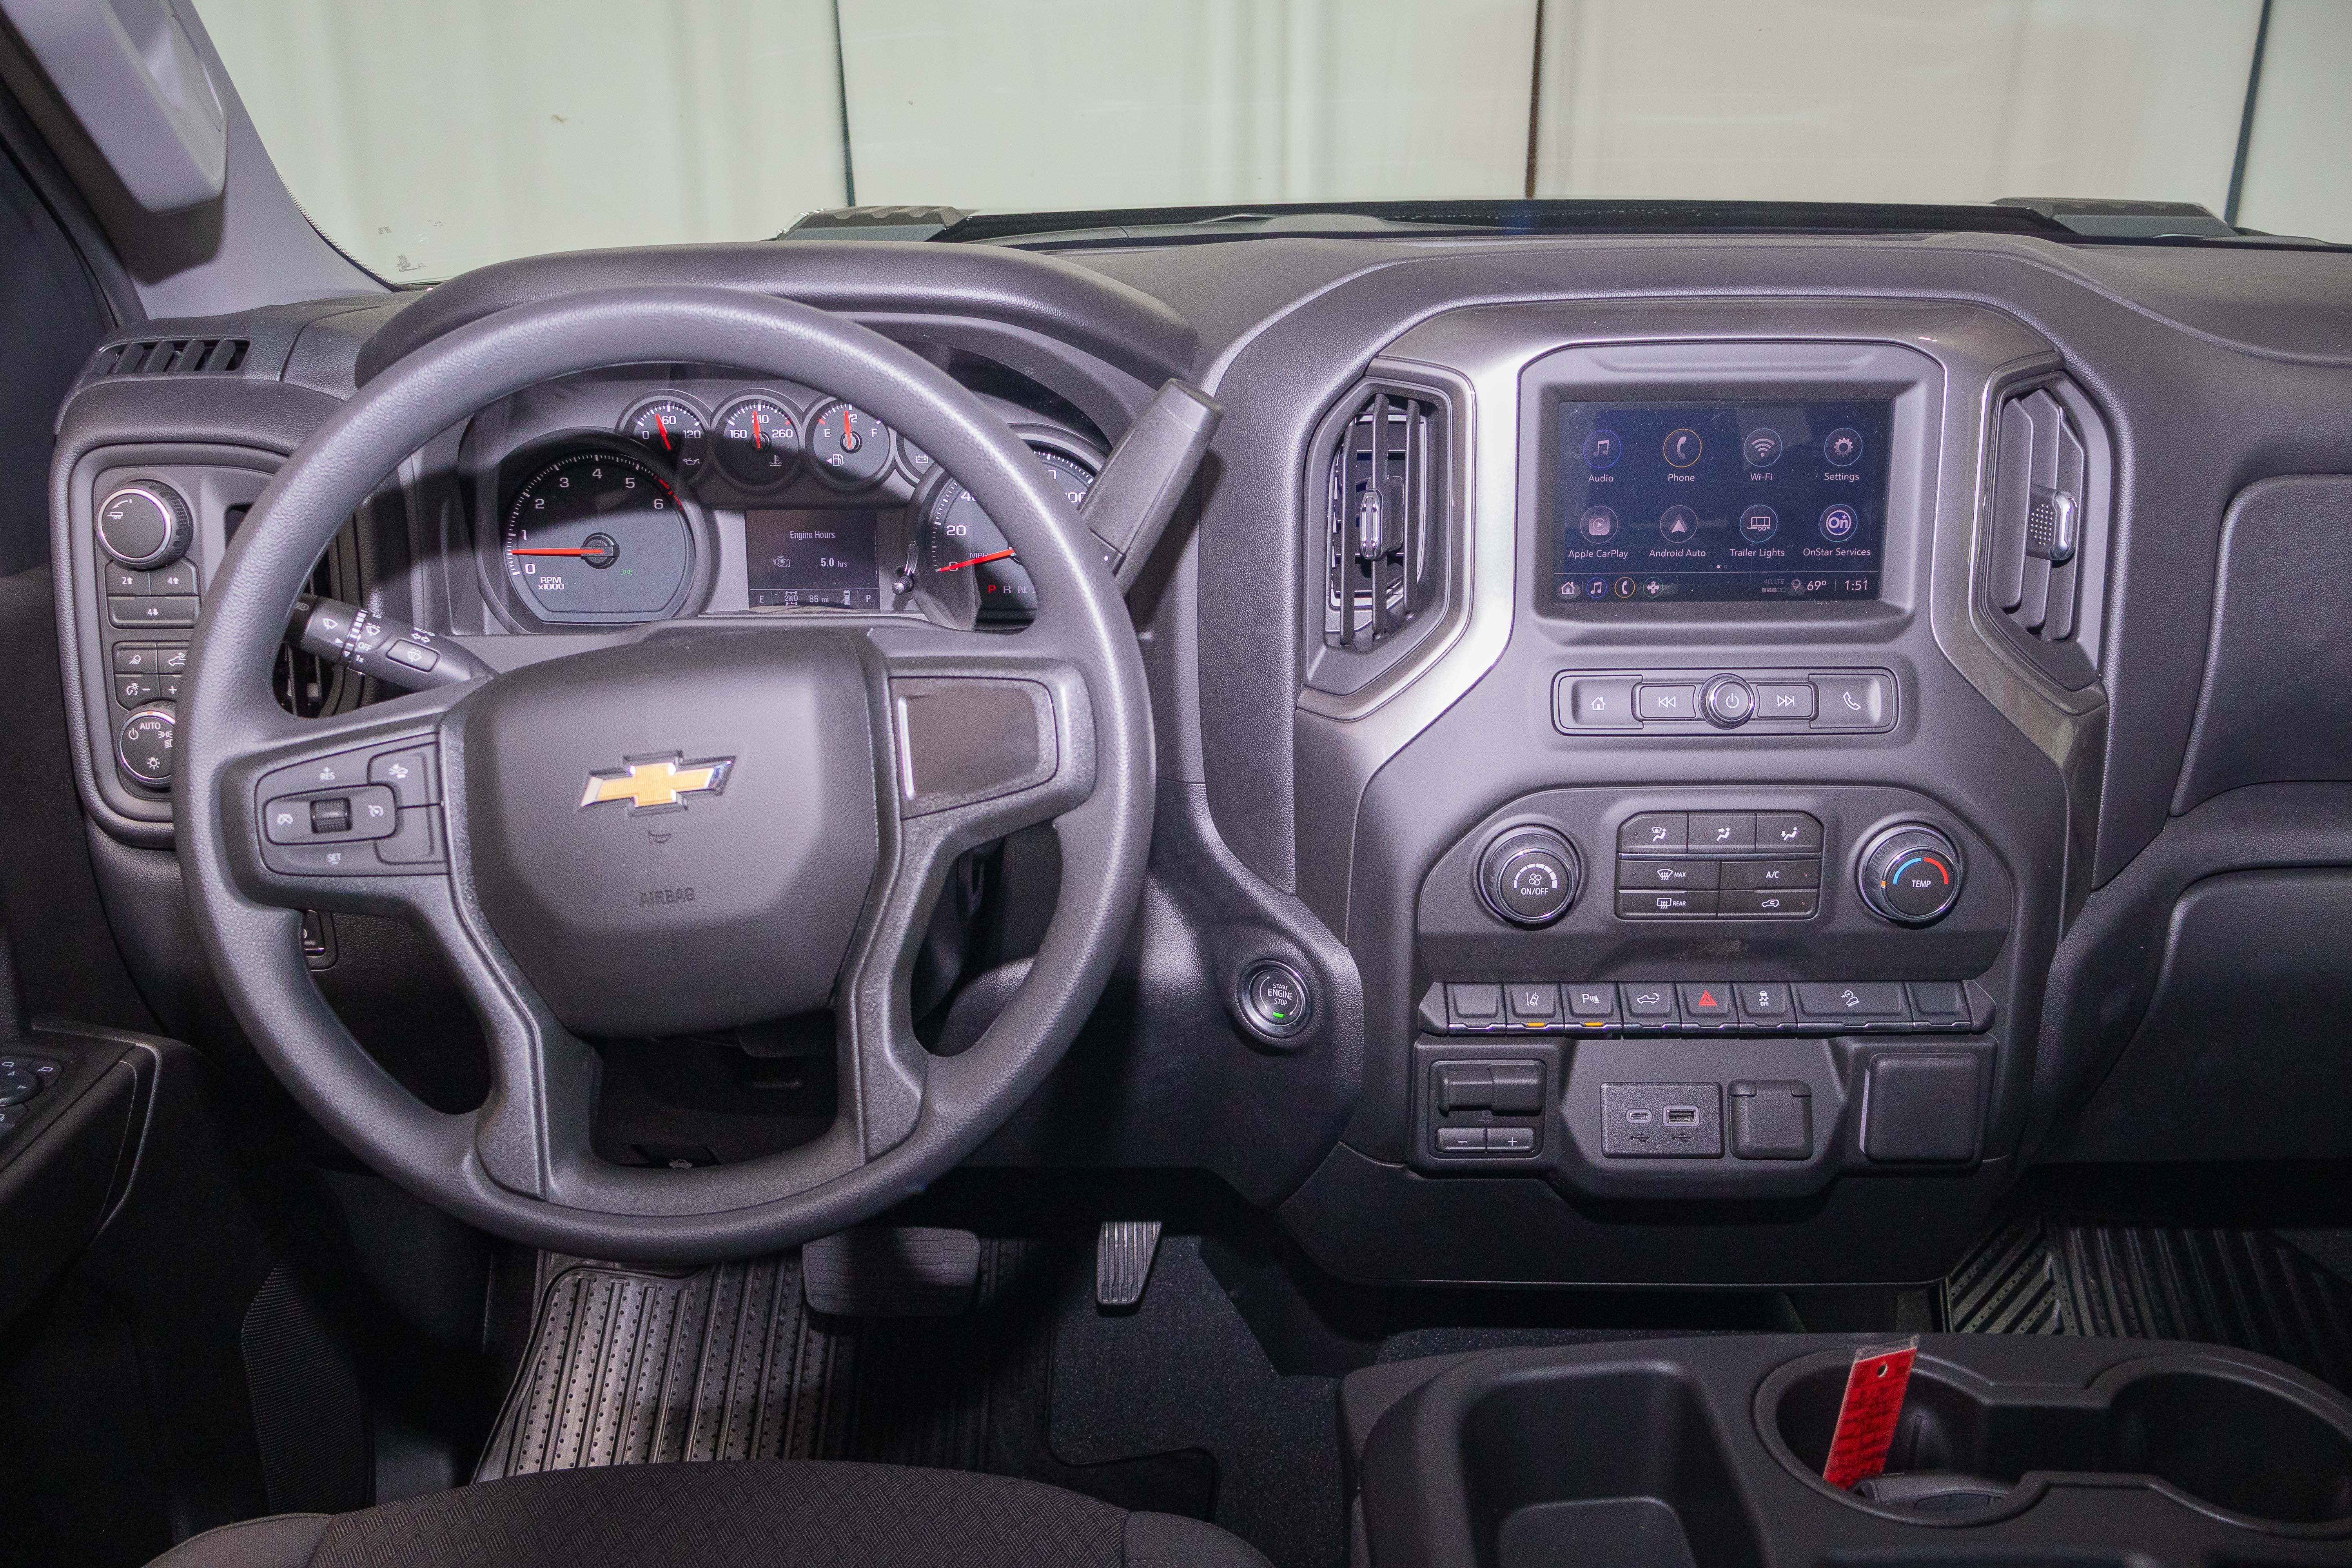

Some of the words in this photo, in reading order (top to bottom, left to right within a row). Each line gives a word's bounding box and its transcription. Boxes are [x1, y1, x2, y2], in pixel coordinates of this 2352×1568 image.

[662, 416, 676, 424] 60
[642, 431, 649, 439] 0
[683, 430, 701, 439] 120
[730, 430, 747, 438] 160
[772, 429, 793, 438] 260
[824, 429, 831, 437] E
[871, 428, 878, 437] F
[592, 469, 602, 478] 4
[1668, 474, 1695, 482] Phone
[1750, 473, 1773, 481] Wi-Fi
[1824, 472, 1860, 482] Settings
[559, 478, 569, 487] 3
[626, 478, 635, 488] 5
[1588, 474, 1614, 483] Audio
[961, 491, 976, 502] 4
[535, 499, 544, 508] 2
[654, 499, 664, 509] 6
[947, 525, 966, 535] 20
[522, 530, 526, 540] 1
[790, 531, 813, 541] Engine
[1568, 550, 1593, 558] Apple
[1597, 549, 1628, 558] CarPlay
[1649, 549, 1682, 557] Android
[1685, 549, 1706, 557] Auto
[1730, 548, 1756, 557] Trailer
[1759, 548, 1785, 558] Lights
[1803, 548, 1833, 556] OnStar
[821, 558, 834, 567] 5.0
[525, 564, 535, 574] 0
[1845, 580, 1868, 590] 1:51
[358, 642, 373, 651] OFF
[320, 772, 335, 780] RES
[327, 853, 341, 862] SET
[639, 887, 694, 906] AIRBAG
[1268, 989, 1293, 1000] ENGINE
